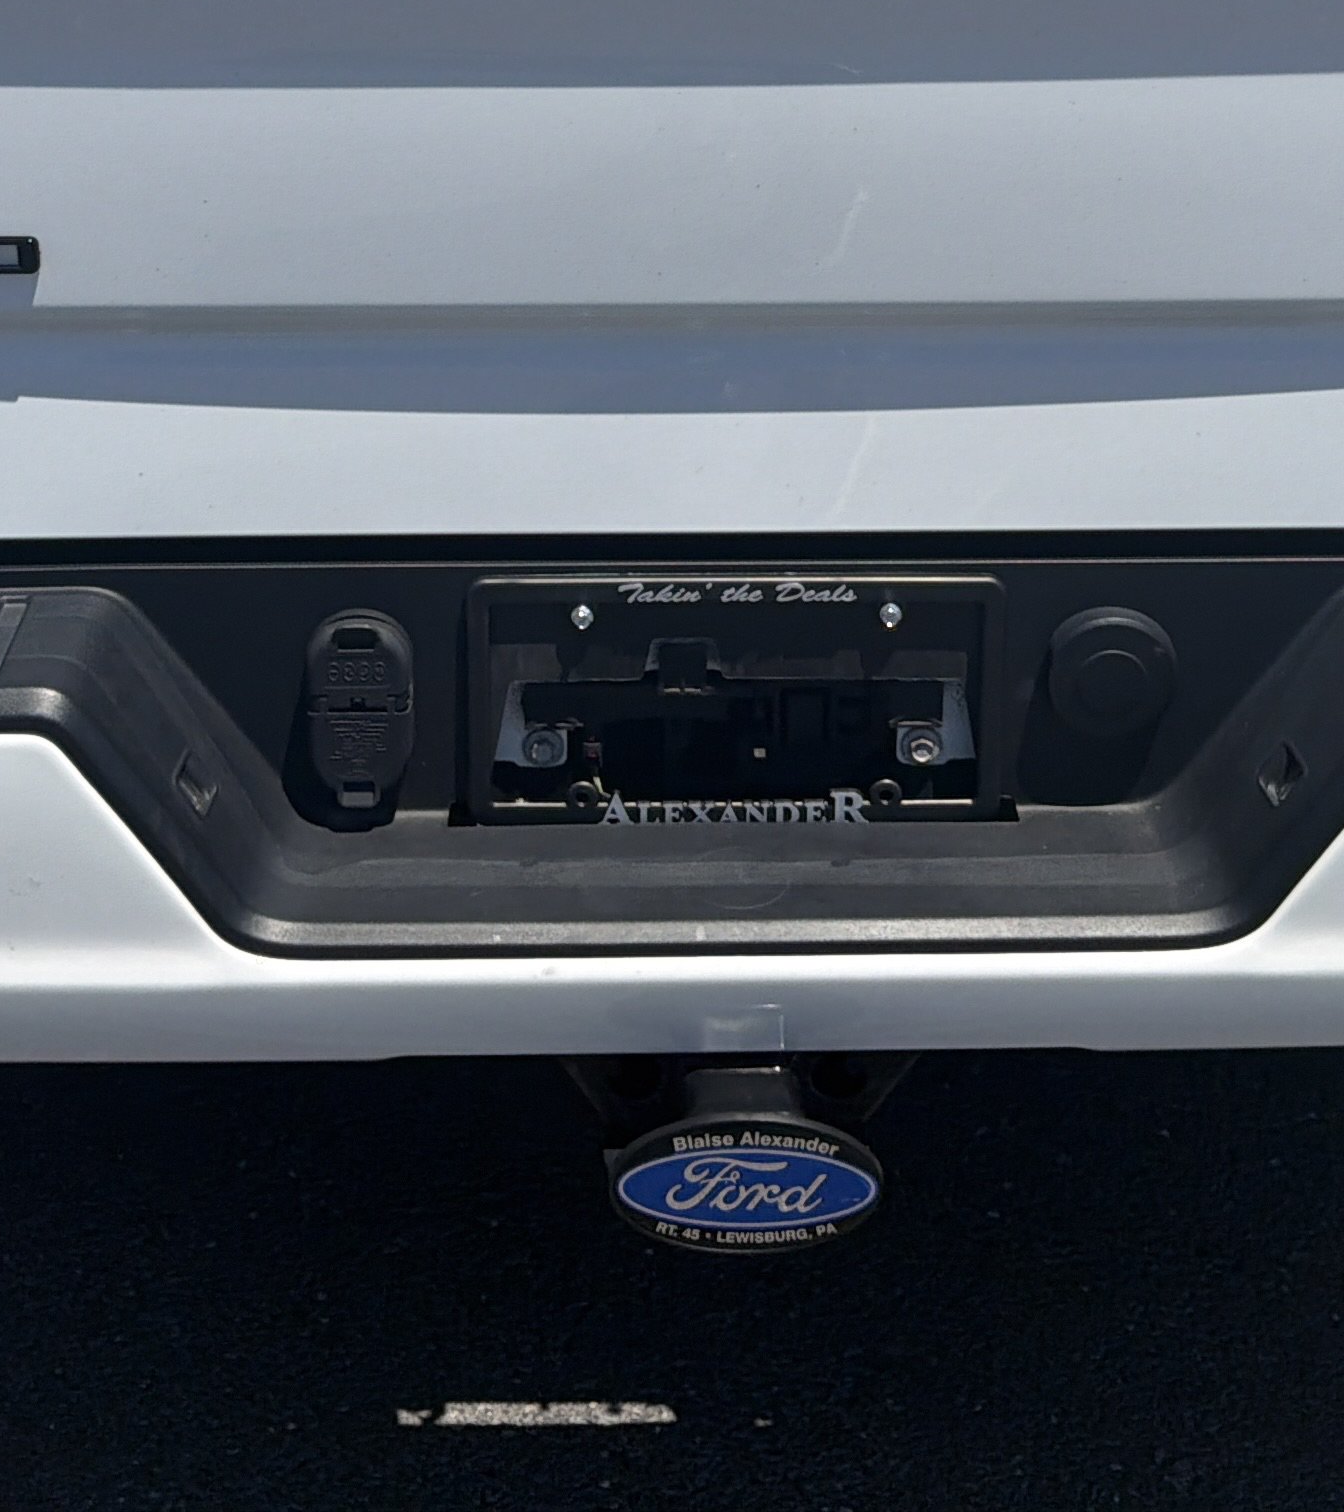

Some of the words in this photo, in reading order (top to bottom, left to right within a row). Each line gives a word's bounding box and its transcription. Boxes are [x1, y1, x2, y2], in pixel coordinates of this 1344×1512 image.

[618, 583, 713, 604] Takin'
[720, 584, 764, 603] the
[774, 582, 857, 602] Deals
[672, 1132, 734, 1152] Blaise
[739, 1131, 840, 1157] Alexander
[665, 1157, 827, 1213] Ford
[682, 1228, 700, 1241] 45
[716, 1228, 813, 1244] LEWISBURG,
[816, 1222, 838, 1236] PA
